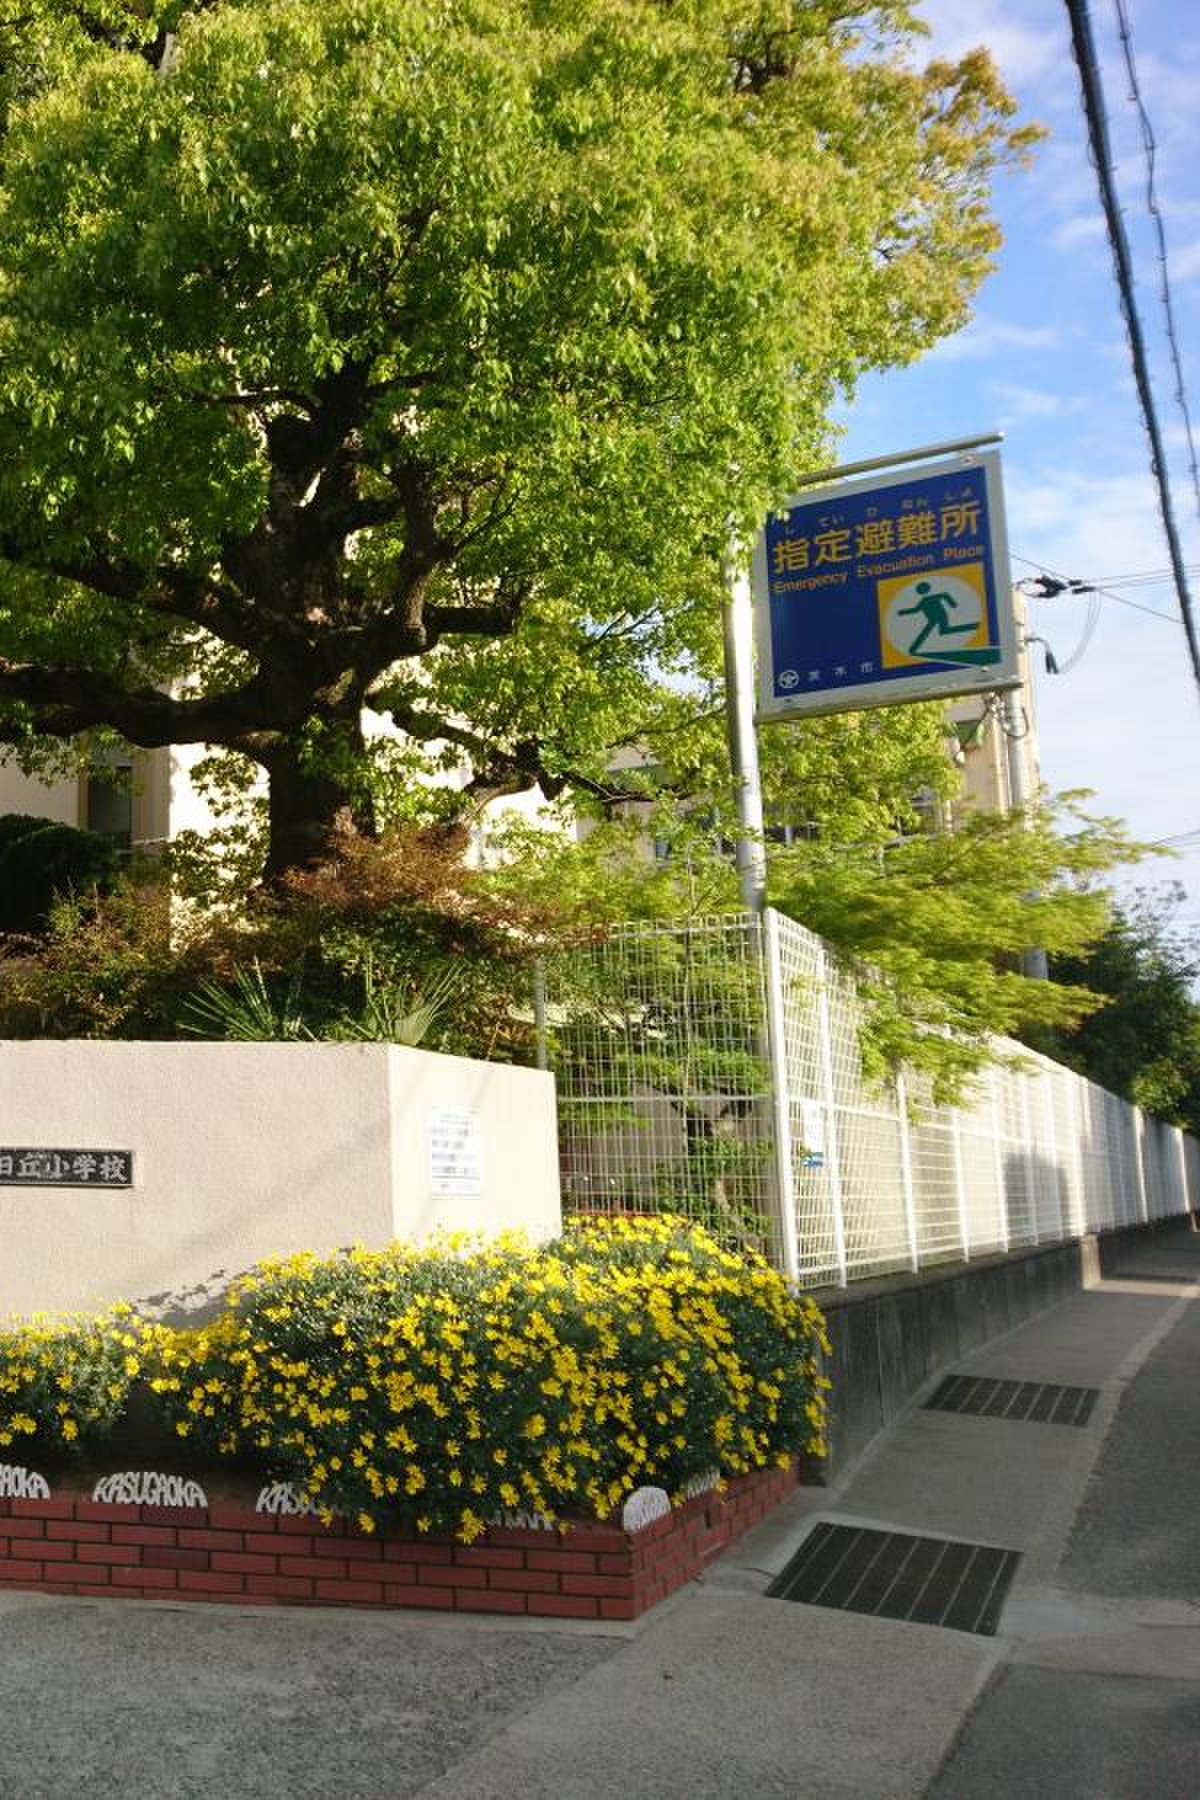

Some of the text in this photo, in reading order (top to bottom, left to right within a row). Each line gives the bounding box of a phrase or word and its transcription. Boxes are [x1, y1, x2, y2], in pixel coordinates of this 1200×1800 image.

[772, 500, 981, 575] 指定避難所
[773, 544, 986, 594] Emergency Evacuation Place
[91, 1471, 209, 1508] KASUGAOKA
